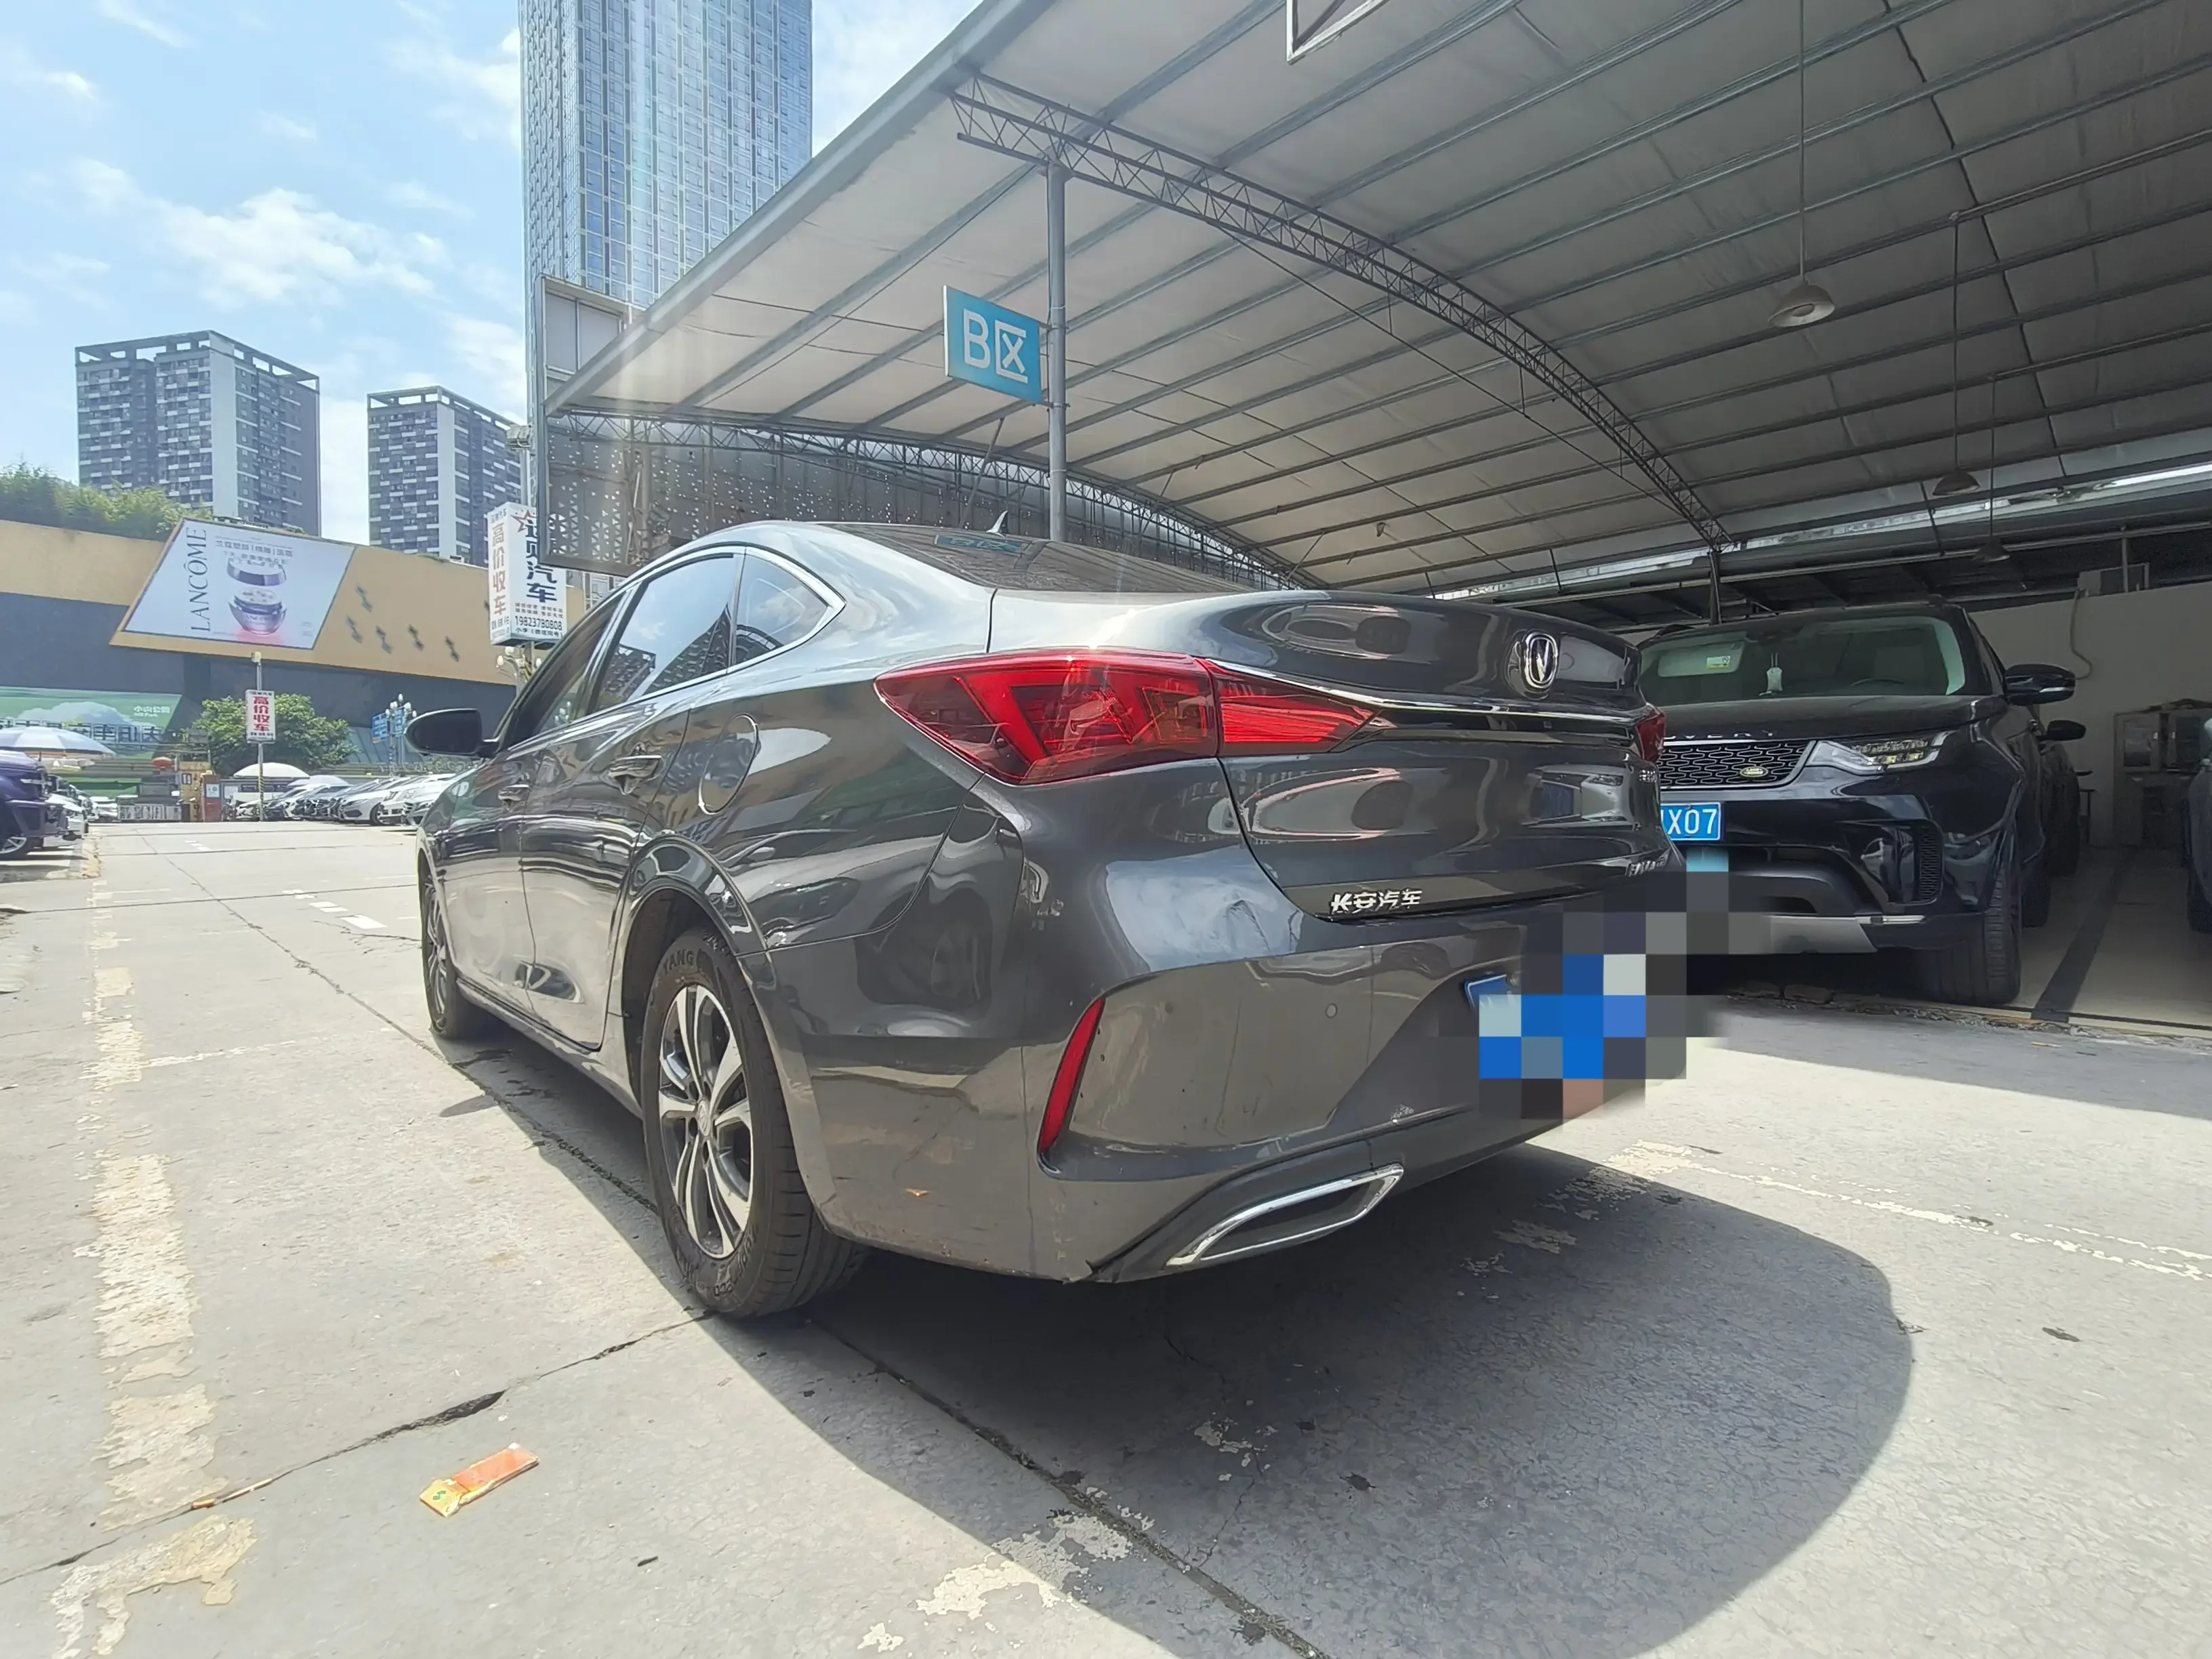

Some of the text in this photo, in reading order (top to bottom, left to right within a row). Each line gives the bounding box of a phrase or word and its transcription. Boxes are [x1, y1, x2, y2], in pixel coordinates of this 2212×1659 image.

[963, 308, 1028, 384] B区
[183, 527, 211, 632] LANCÔME
[491, 523, 506, 615] 高价收车
[253, 696, 270, 731] 高价收车
[1330, 888, 1422, 914] 长安汽车
